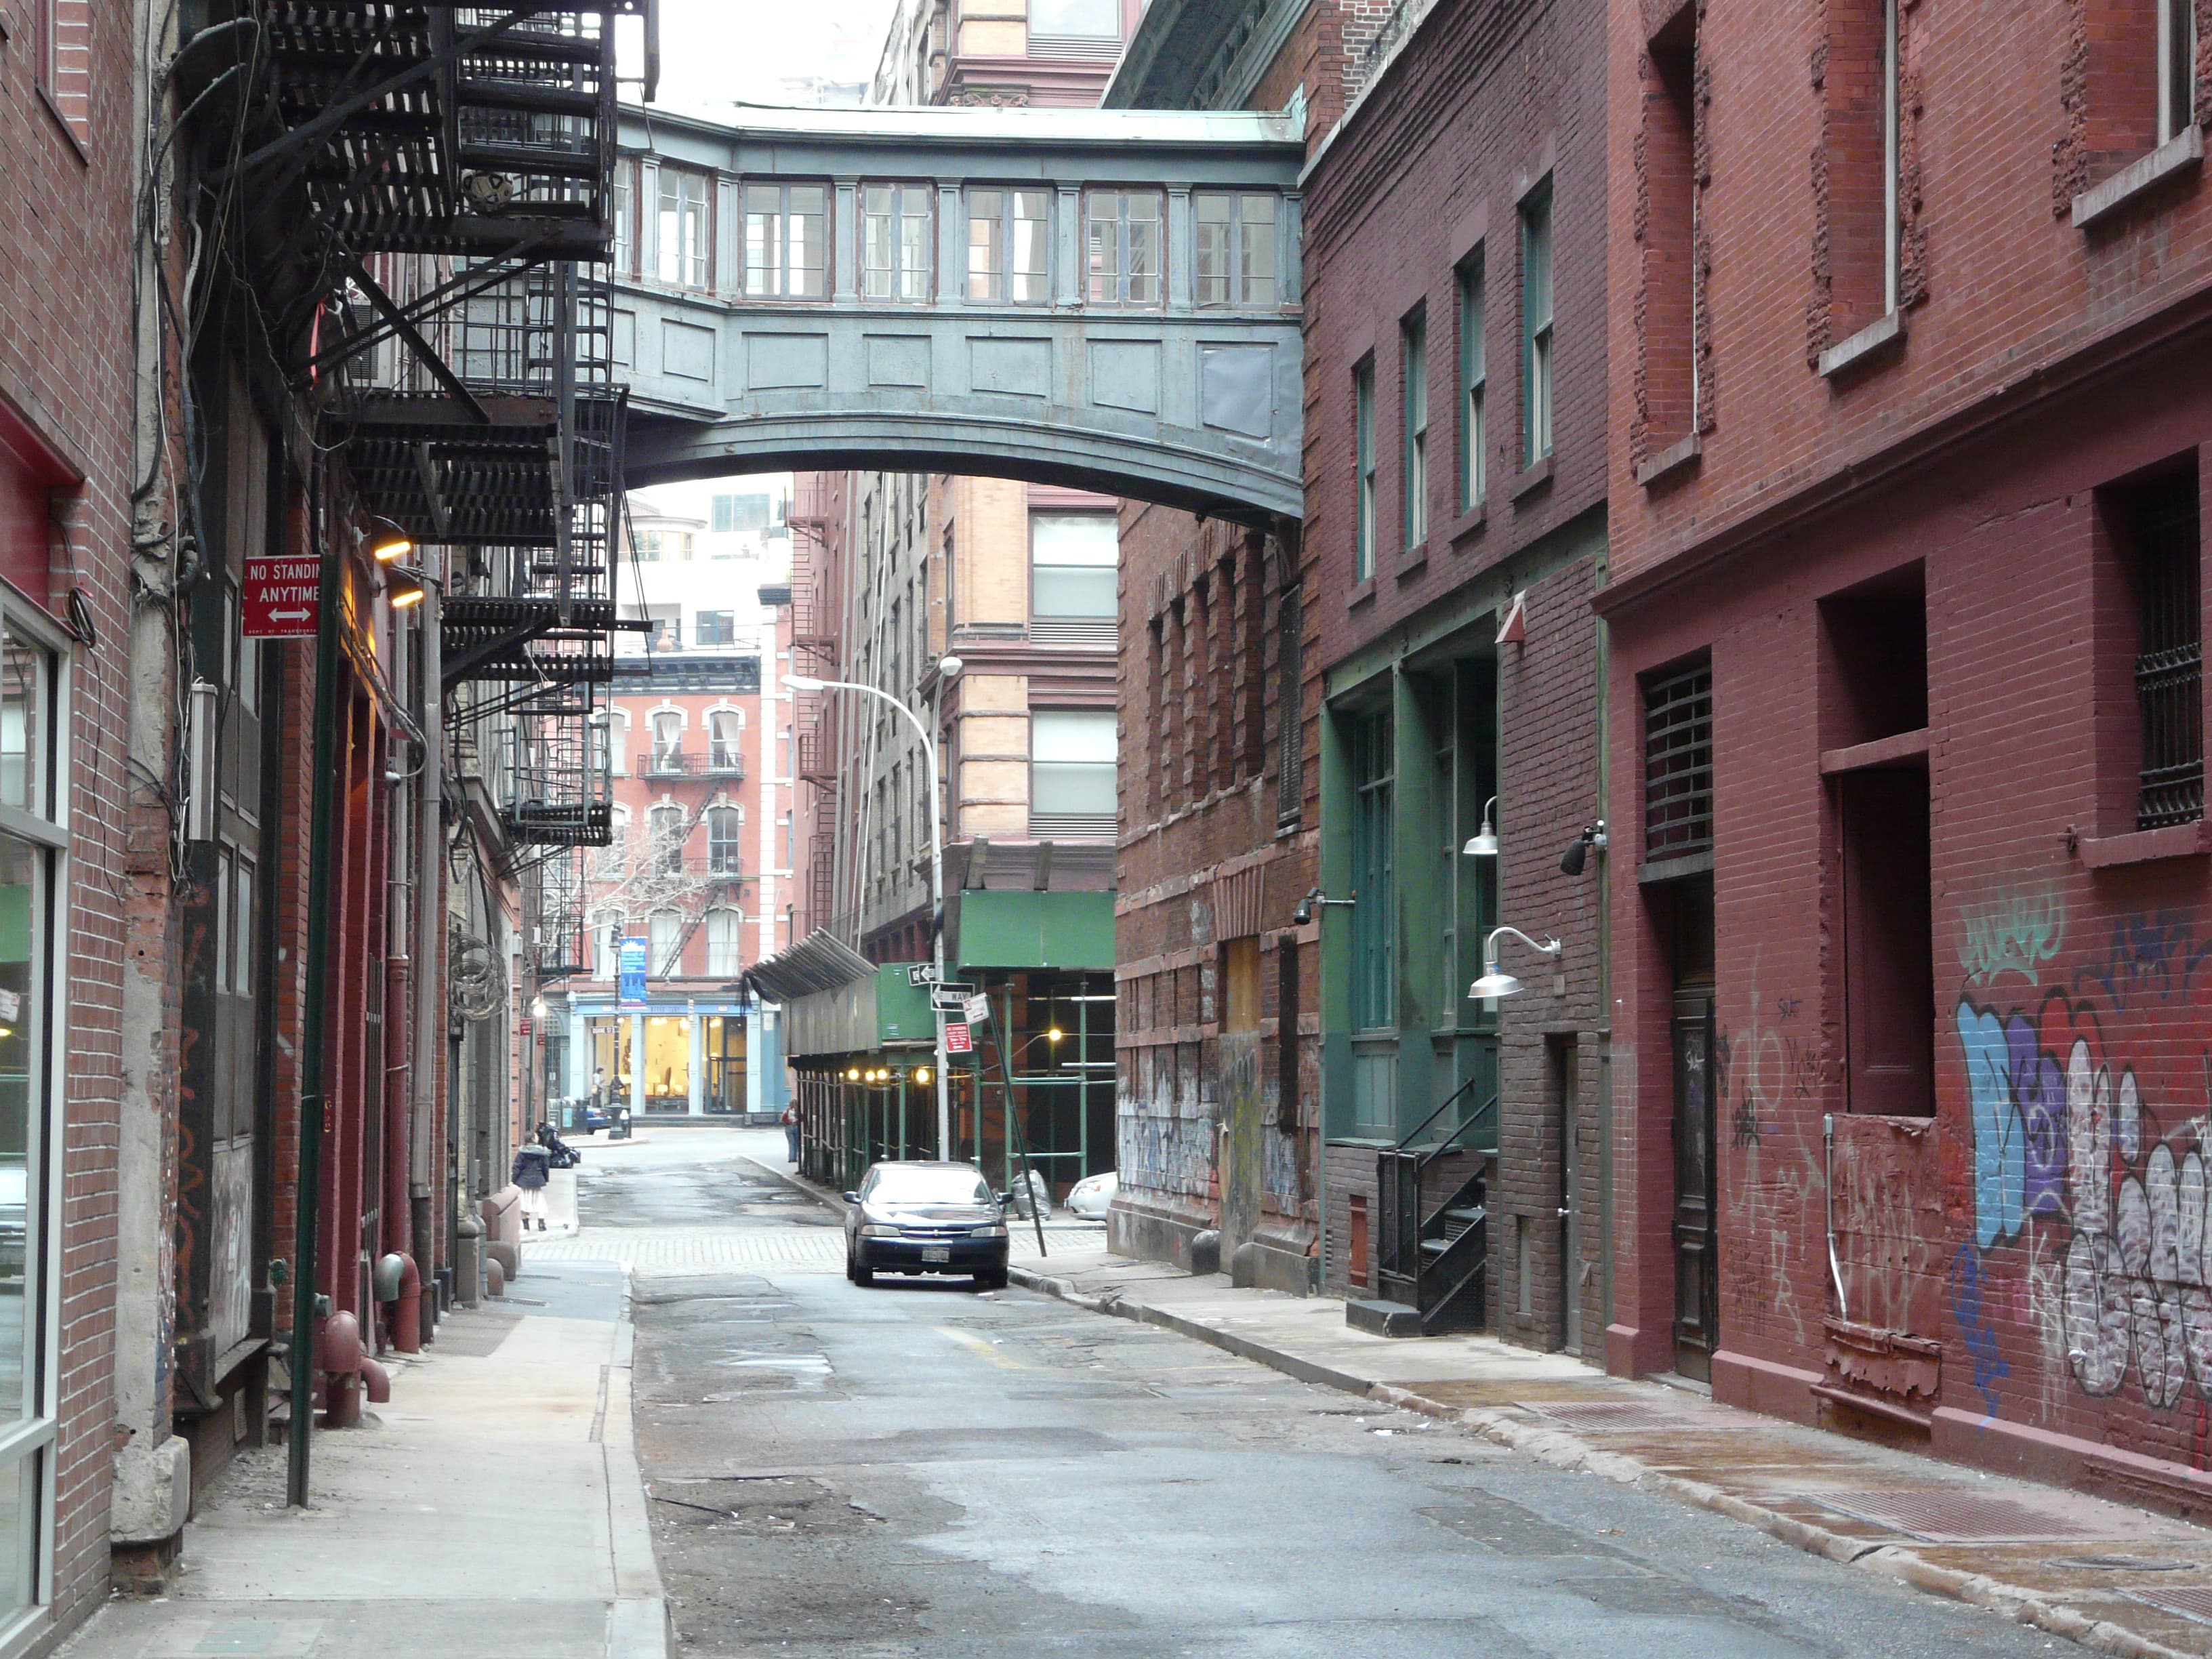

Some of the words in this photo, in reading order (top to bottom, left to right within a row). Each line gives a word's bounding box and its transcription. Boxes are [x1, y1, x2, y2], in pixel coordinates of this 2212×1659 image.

[251, 565, 266, 581] NO
[273, 563, 321, 580] STANDIN
[259, 586, 320, 602] ANYTIME
[951, 992, 967, 1001] WAY
